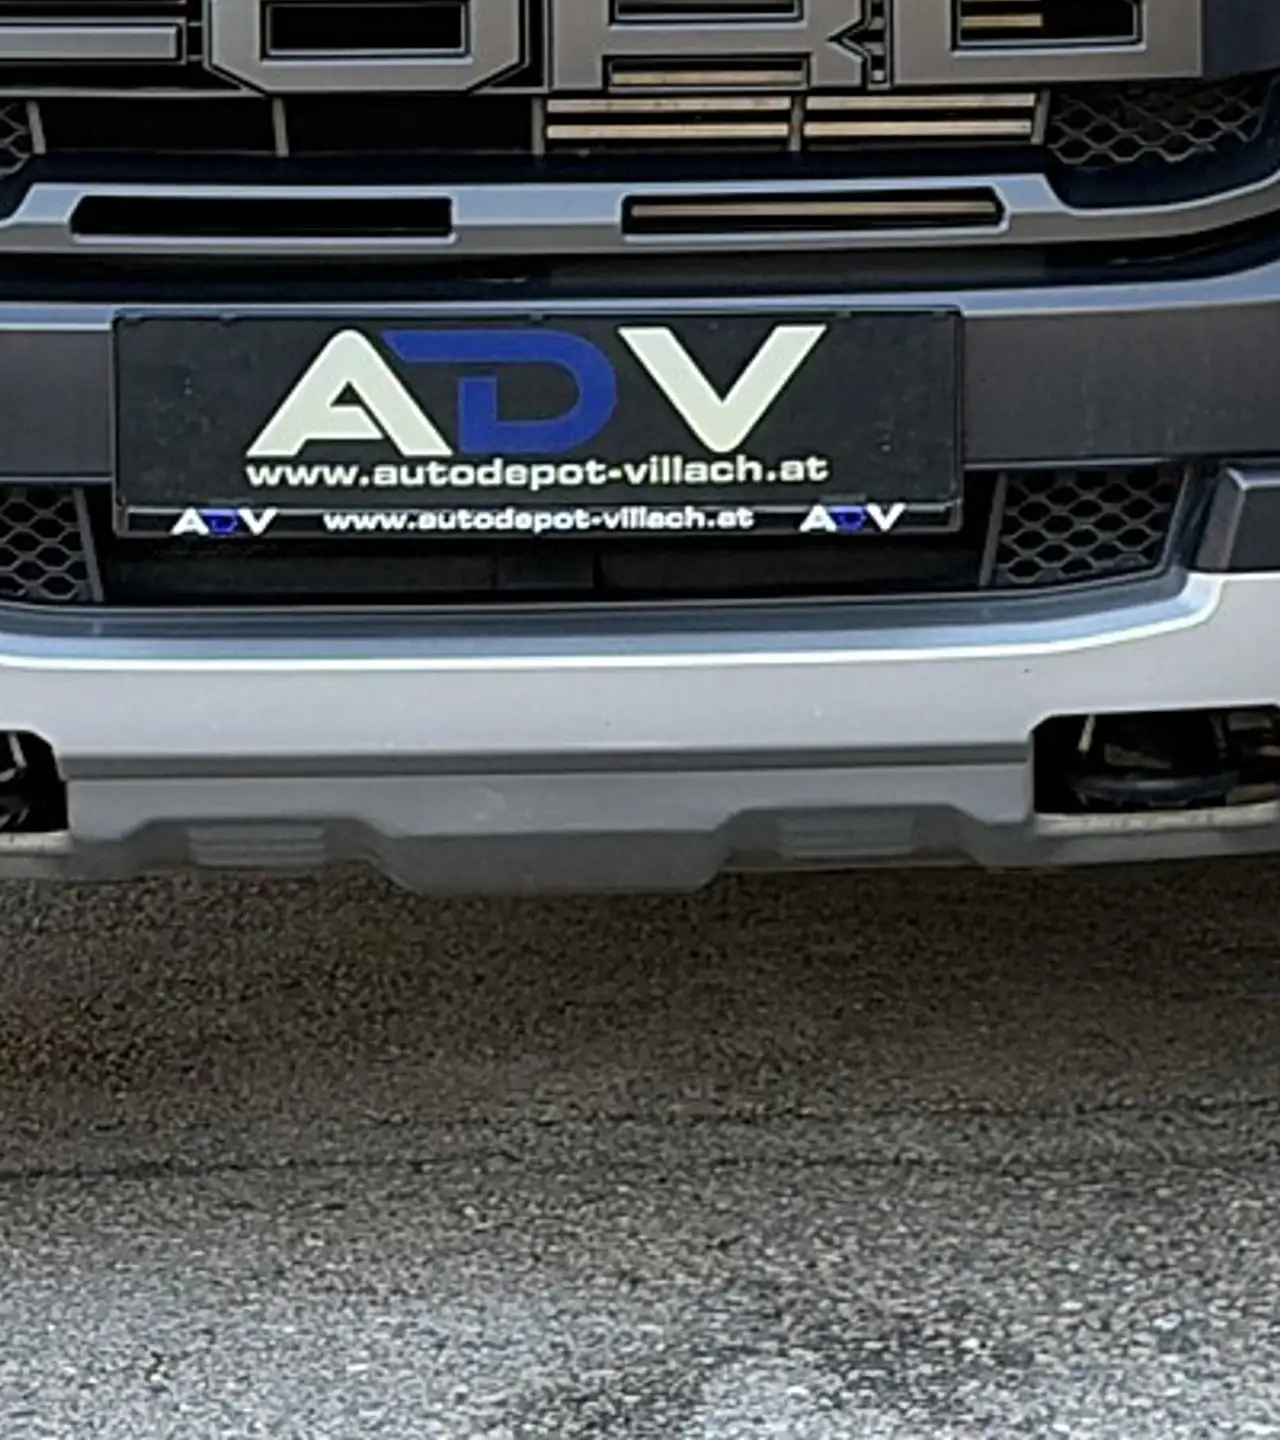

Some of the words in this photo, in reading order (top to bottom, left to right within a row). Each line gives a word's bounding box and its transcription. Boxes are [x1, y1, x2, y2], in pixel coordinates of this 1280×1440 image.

[245, 324, 827, 458] ADV
[245, 455, 830, 491] www.autodepot-villach.at
[170, 506, 279, 537] ADV
[323, 505, 755, 534] www.autodepot-villach.at
[799, 502, 907, 533] ADV
